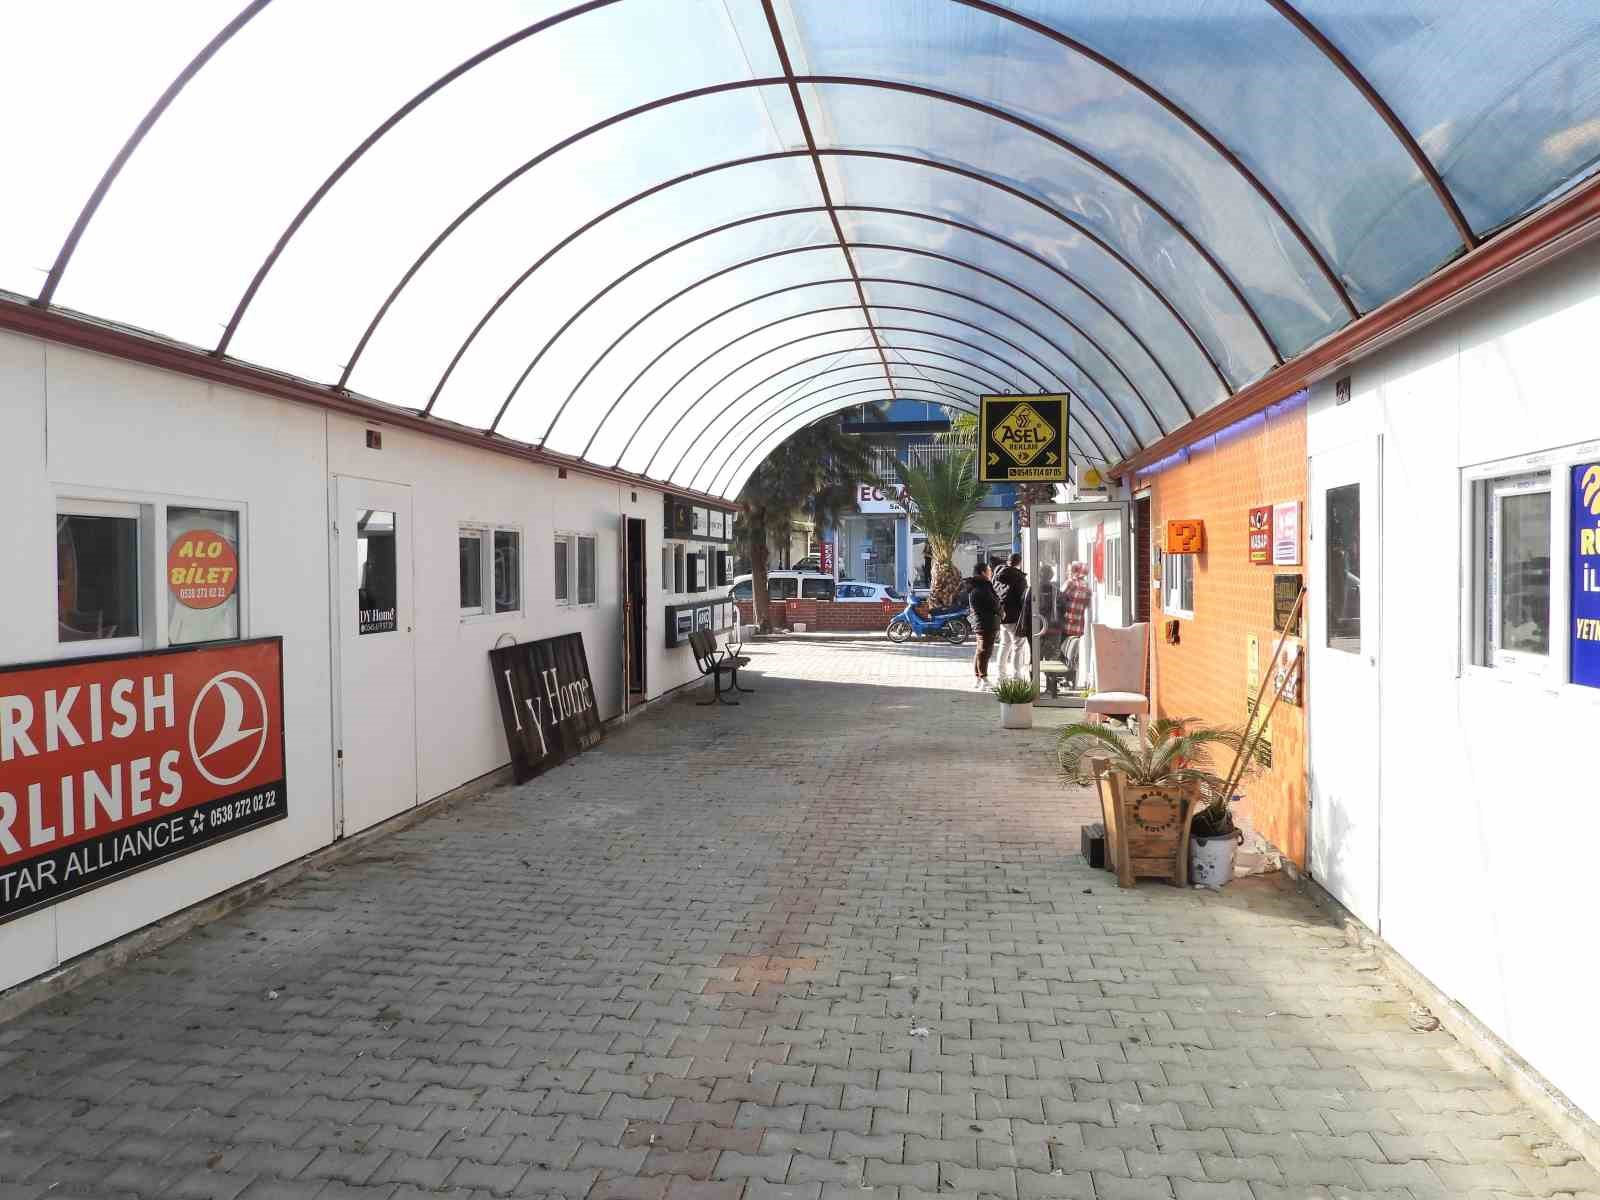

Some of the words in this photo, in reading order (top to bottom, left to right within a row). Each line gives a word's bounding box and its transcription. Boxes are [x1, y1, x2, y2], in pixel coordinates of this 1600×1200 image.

[1001, 425, 1046, 443] ASEL
[178, 540, 223, 558] ALO
[170, 562, 234, 585] BİLET
[0, 673, 175, 762] RKISH
[64, 816, 185, 883] ALLIANCE
[210, 803, 233, 827] 0538
[234, 797, 251, 816] 272
[252, 793, 264, 812] 02
[265, 789, 276, 809] 22
